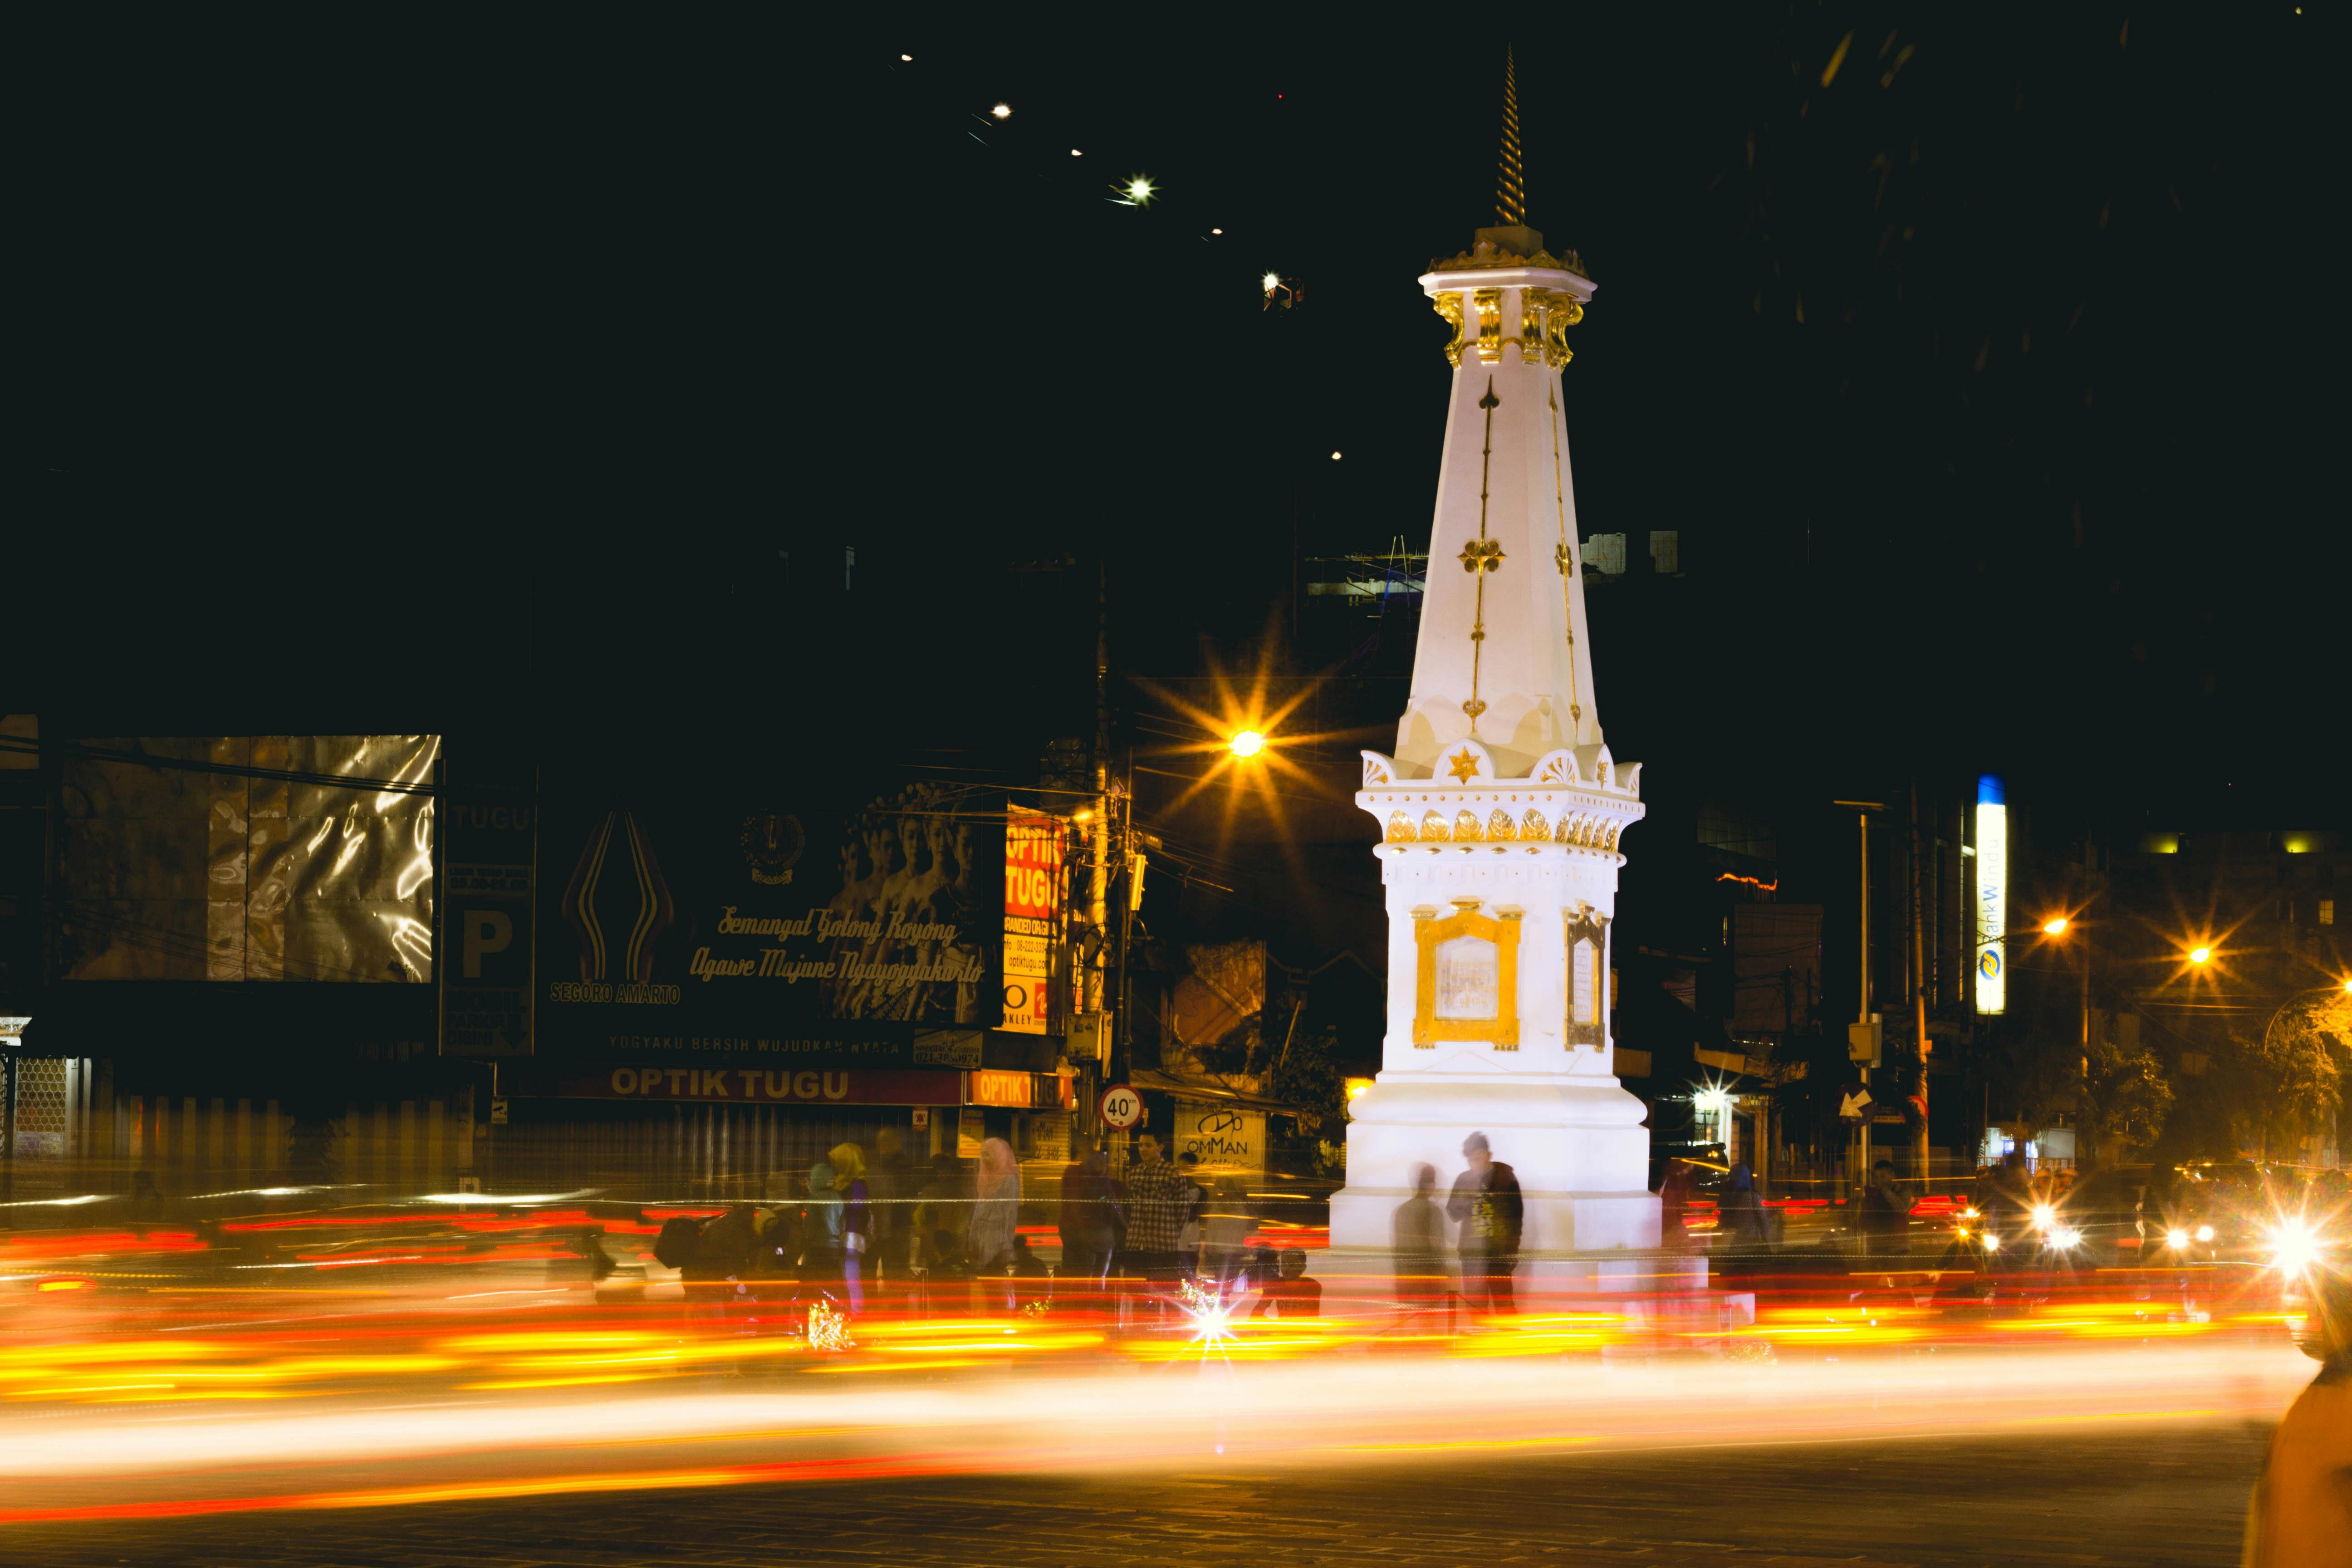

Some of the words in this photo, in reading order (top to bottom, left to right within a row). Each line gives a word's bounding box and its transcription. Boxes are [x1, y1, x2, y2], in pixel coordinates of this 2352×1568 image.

[451, 805, 530, 831] TUGU
[1006, 825, 1061, 865] OPTIK
[1005, 866, 1059, 909] TUGU
[718, 905, 815, 943] Semangat
[815, 908, 887, 947] Gotong
[886, 911, 960, 947] Royong
[463, 909, 514, 979] P
[689, 946, 757, 983] Agawe
[758, 948, 837, 984] Majune
[1009, 955, 1049, 971] optiktugu.co
[446, 991, 527, 1013] MOBIL
[549, 981, 613, 1003] SEGORO
[615, 983, 681, 1004] AMARTO
[446, 1013, 506, 1029] PARKIR
[446, 1030, 493, 1046] DISINI
[609, 1035, 683, 1050] YOGYAKU
[691, 1038, 749, 1051] BERSIH
[758, 1038, 843, 1054] WUJUDKAN
[851, 1041, 901, 1054] NYATA
[611, 1067, 730, 1097] OPTIK
[738, 1069, 849, 1100] TUGU
[980, 1074, 1022, 1102] OPTIK
[1024, 1076, 1064, 1105] TUGU
[1107, 1098, 1128, 1117] 40
[1187, 1137, 1248, 1155] OMMAN
